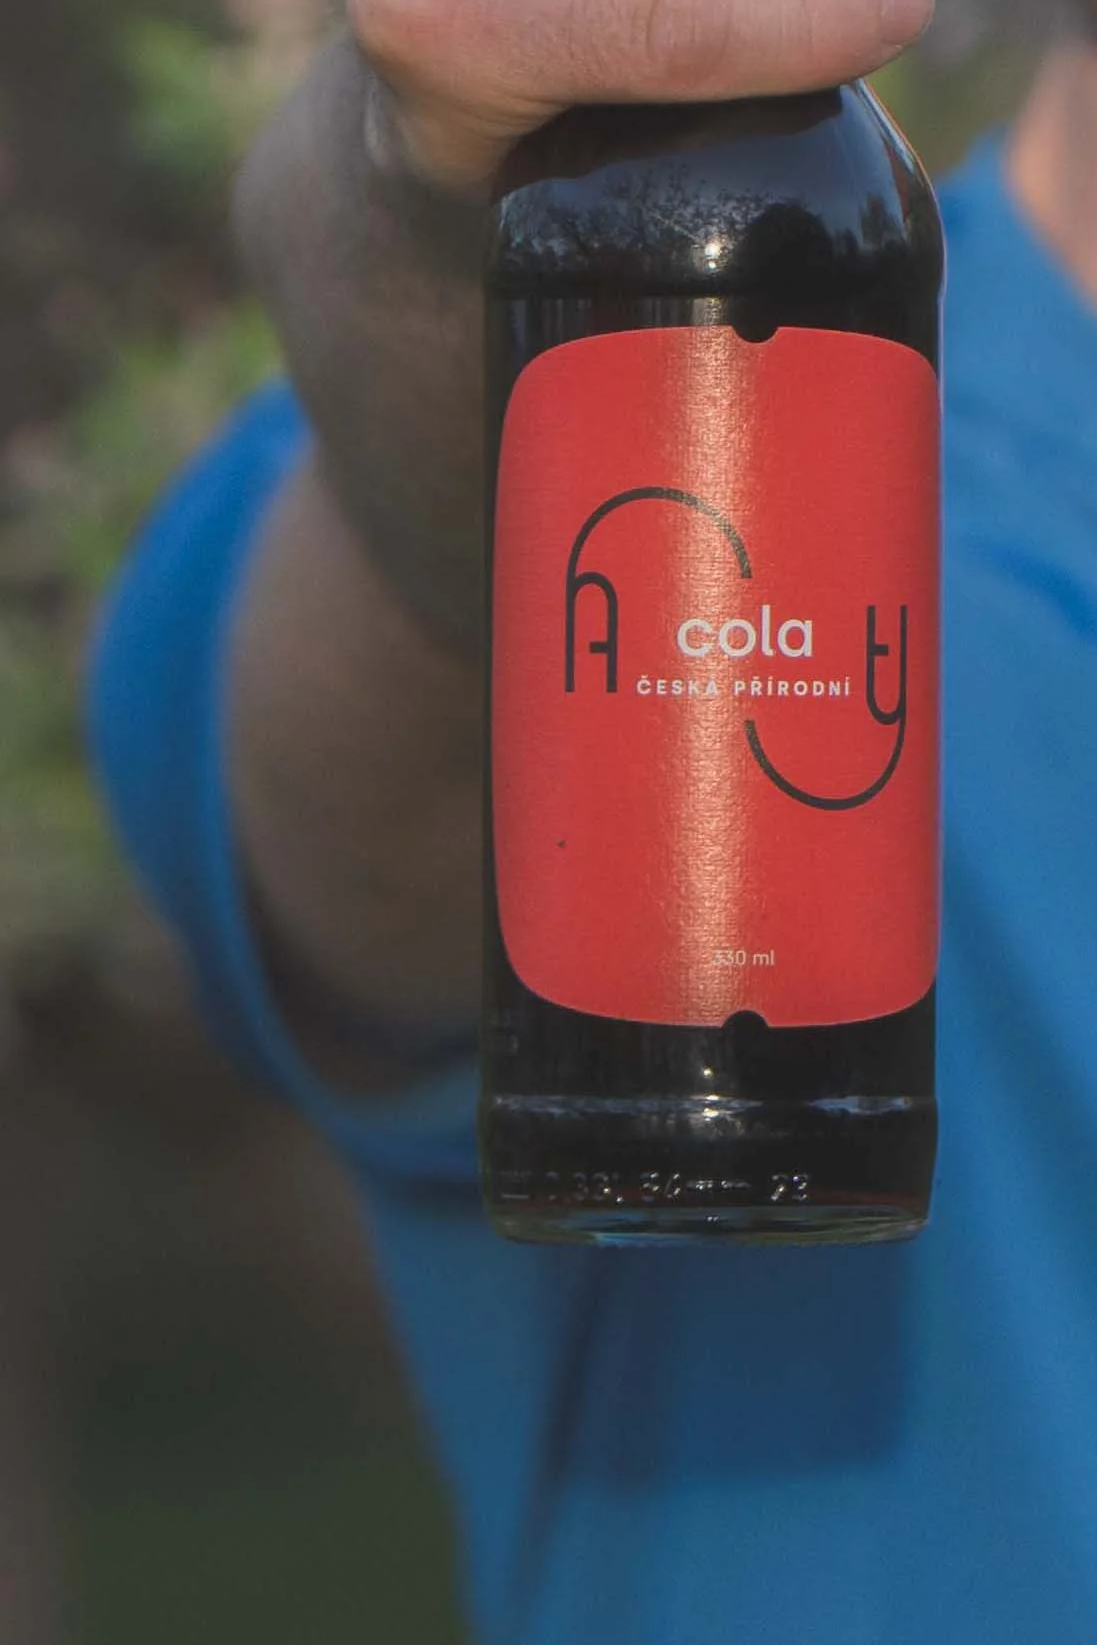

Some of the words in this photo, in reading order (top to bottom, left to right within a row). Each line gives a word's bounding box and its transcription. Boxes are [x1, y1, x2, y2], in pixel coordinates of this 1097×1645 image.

[676, 604, 814, 658] cola
[635, 675, 719, 696] ČESKÁ
[733, 675, 852, 696] PŘÍRODNÍ
[711, 948, 747, 966] 330
[752, 949, 775, 966] ml
